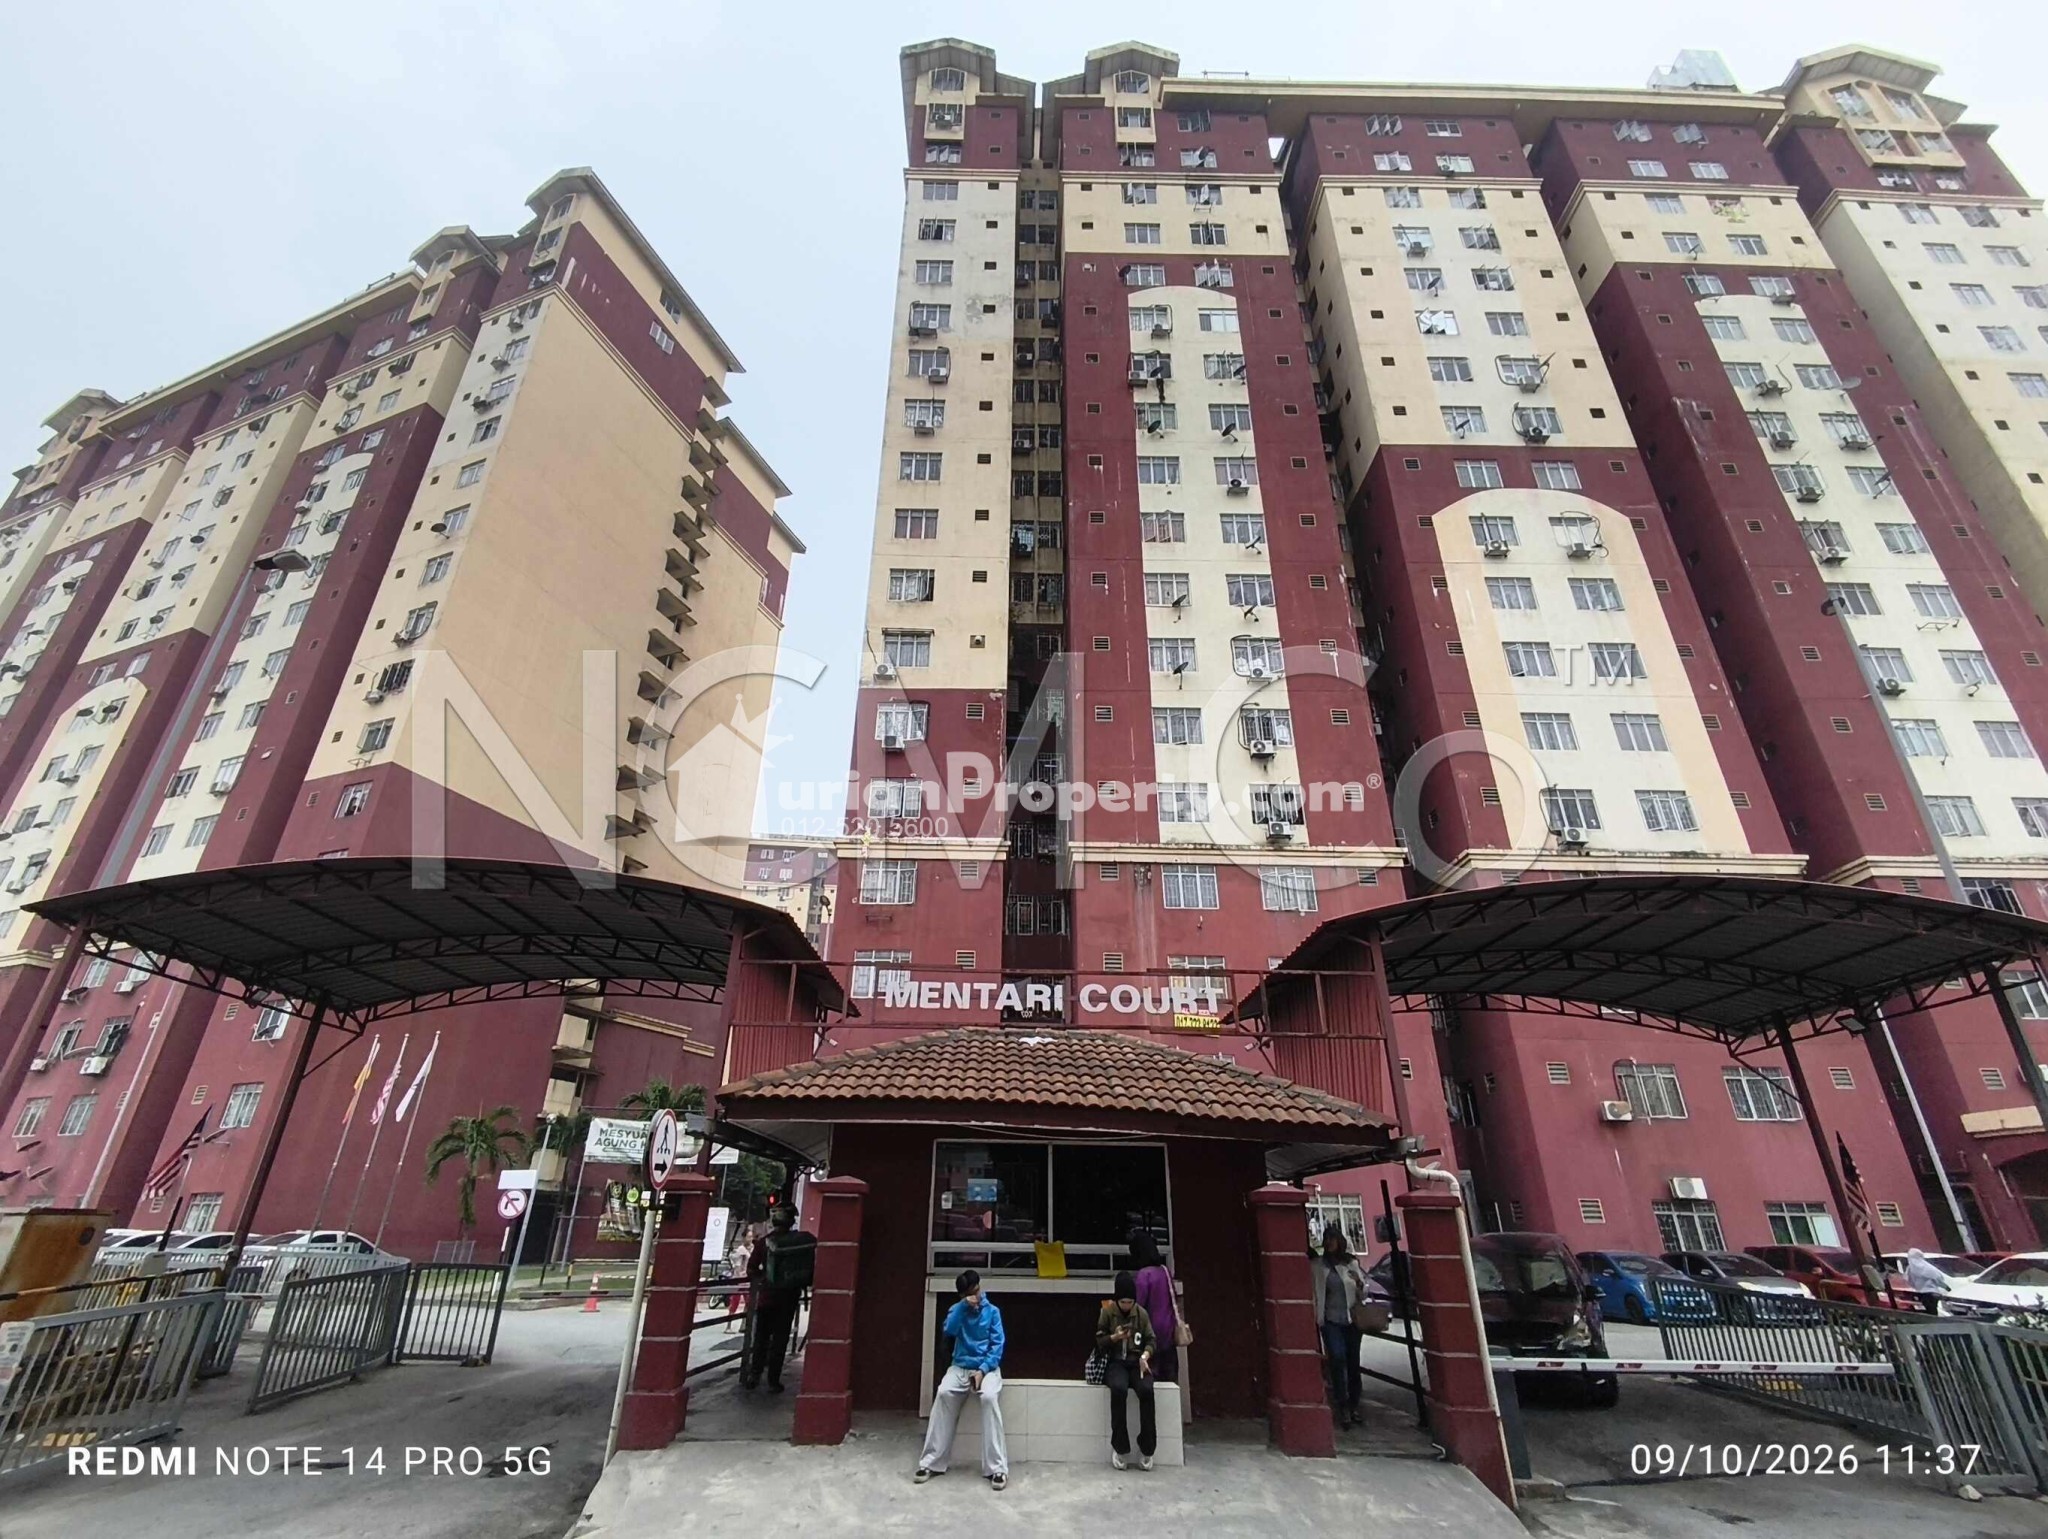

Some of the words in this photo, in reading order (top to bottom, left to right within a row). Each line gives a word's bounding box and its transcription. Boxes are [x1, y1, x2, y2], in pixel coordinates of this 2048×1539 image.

[885, 981, 1064, 1011] MENTARI
[1079, 984, 1223, 1015] COURT
[599, 1128, 648, 1140] MESYUA
[594, 1137, 638, 1149] AGUNG
[1134, 1332, 1142, 1345] C
